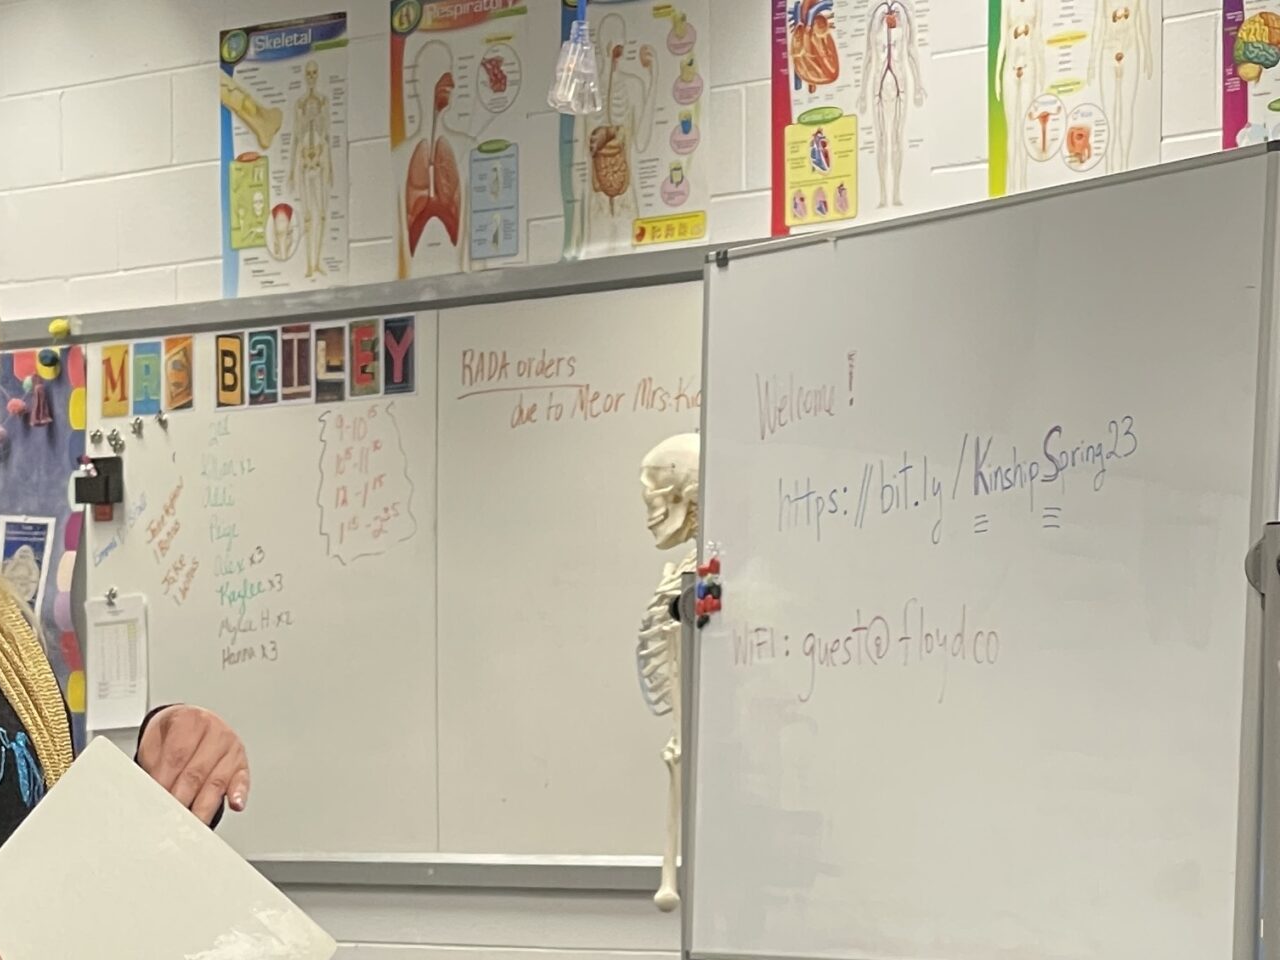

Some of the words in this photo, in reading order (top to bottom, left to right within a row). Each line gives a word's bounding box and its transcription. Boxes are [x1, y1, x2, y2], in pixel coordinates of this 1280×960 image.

[255, 29, 312, 52] Skeletal
[462, 349, 510, 386] RADA
[517, 349, 576, 378] orders
[510, 394, 537, 428] due
[545, 392, 564, 421] to
[604, 392, 626, 413] or
[755, 351, 857, 440] Welcome!
